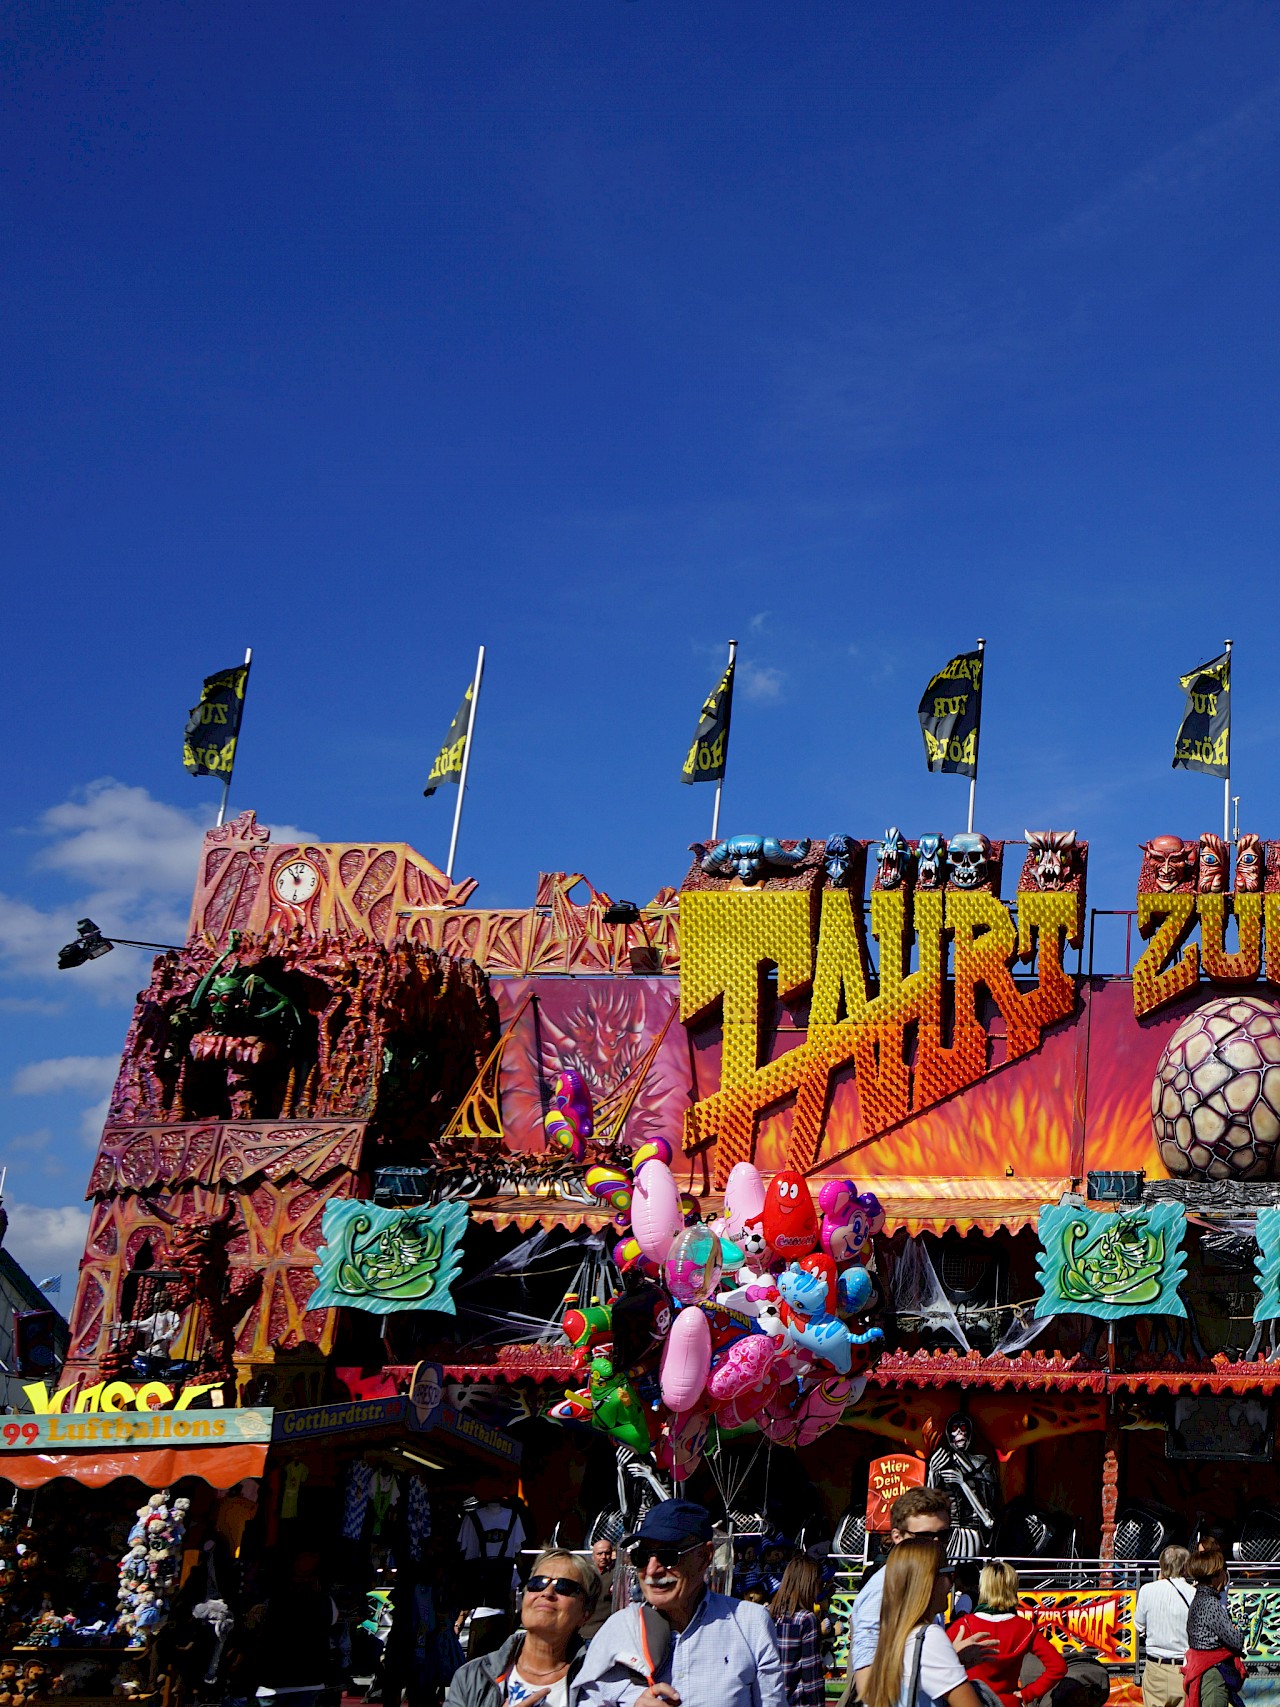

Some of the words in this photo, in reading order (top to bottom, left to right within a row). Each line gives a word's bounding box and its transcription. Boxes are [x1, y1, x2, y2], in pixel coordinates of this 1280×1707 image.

[295, 864, 305, 873] 12
[310, 877, 315, 887] 3
[679, 890, 1079, 1192] FAHRT
[2, 1422, 40, 1446] 99
[47, 1415, 226, 1441] Luftballons
[283, 1404, 384, 1434] Gotthardtstr.
[456, 1412, 513, 1455] Luftballons
[873, 1474, 901, 1489] Dein
[880, 1460, 910, 1475] Hier
[1037, 1610, 1064, 1626] ZUR
[1067, 1600, 1116, 1653] HÖLLE
